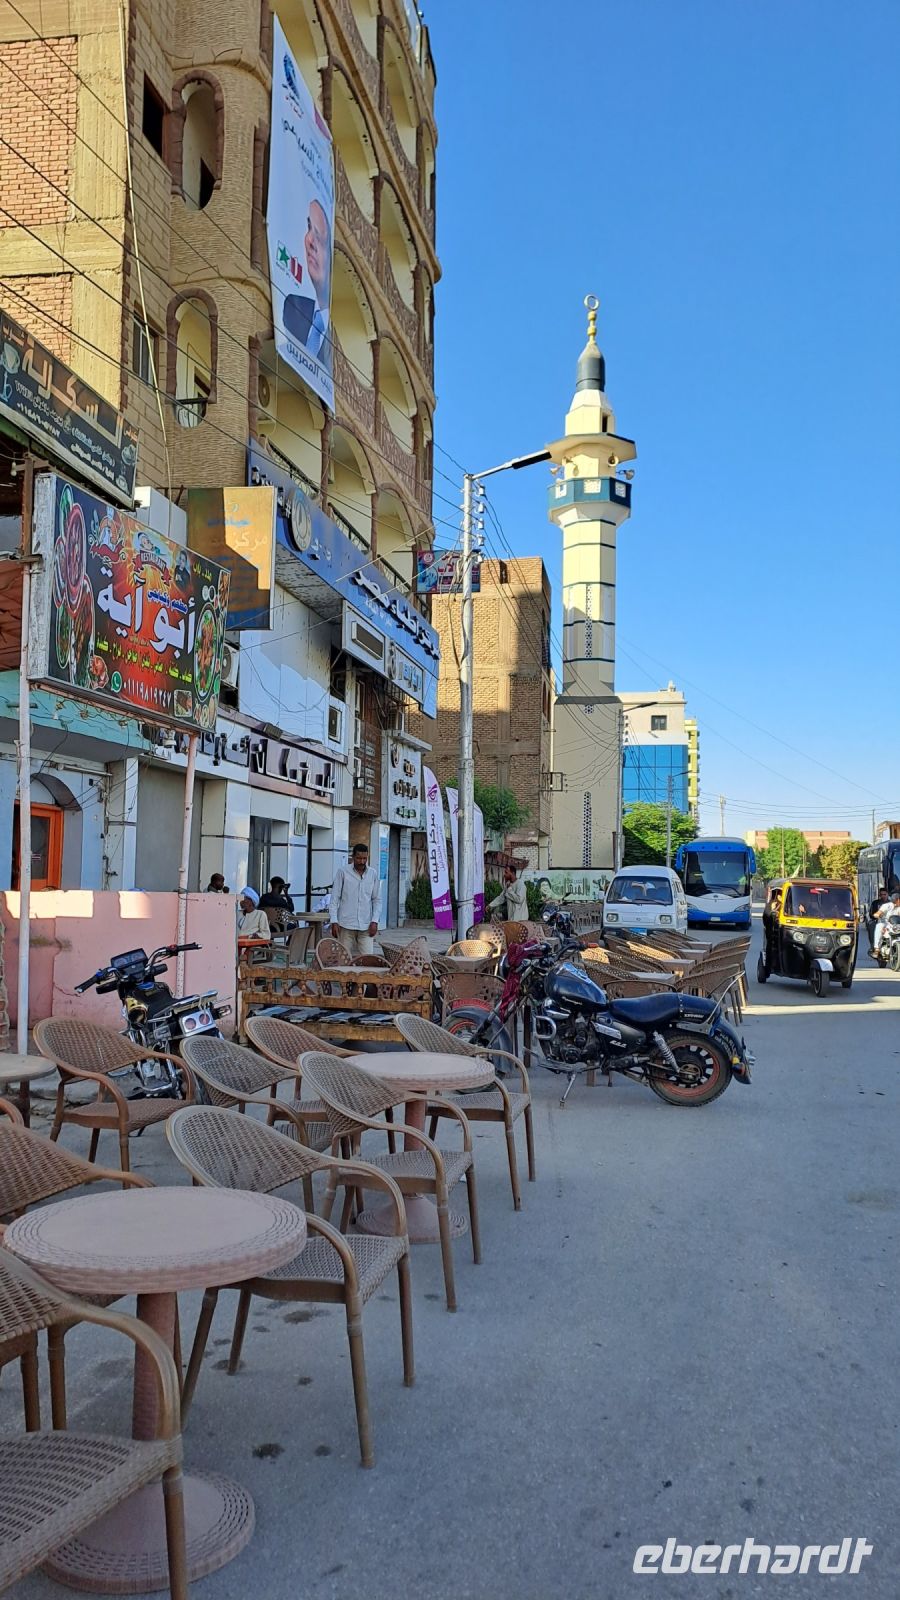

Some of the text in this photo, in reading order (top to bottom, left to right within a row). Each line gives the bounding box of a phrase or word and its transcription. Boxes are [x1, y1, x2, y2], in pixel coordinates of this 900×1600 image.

[286, 339, 319, 379] المصريين
[97, 566, 196, 660] أبو آية
[429, 813, 437, 844] مركز
[430, 848, 440, 884] طيبة
